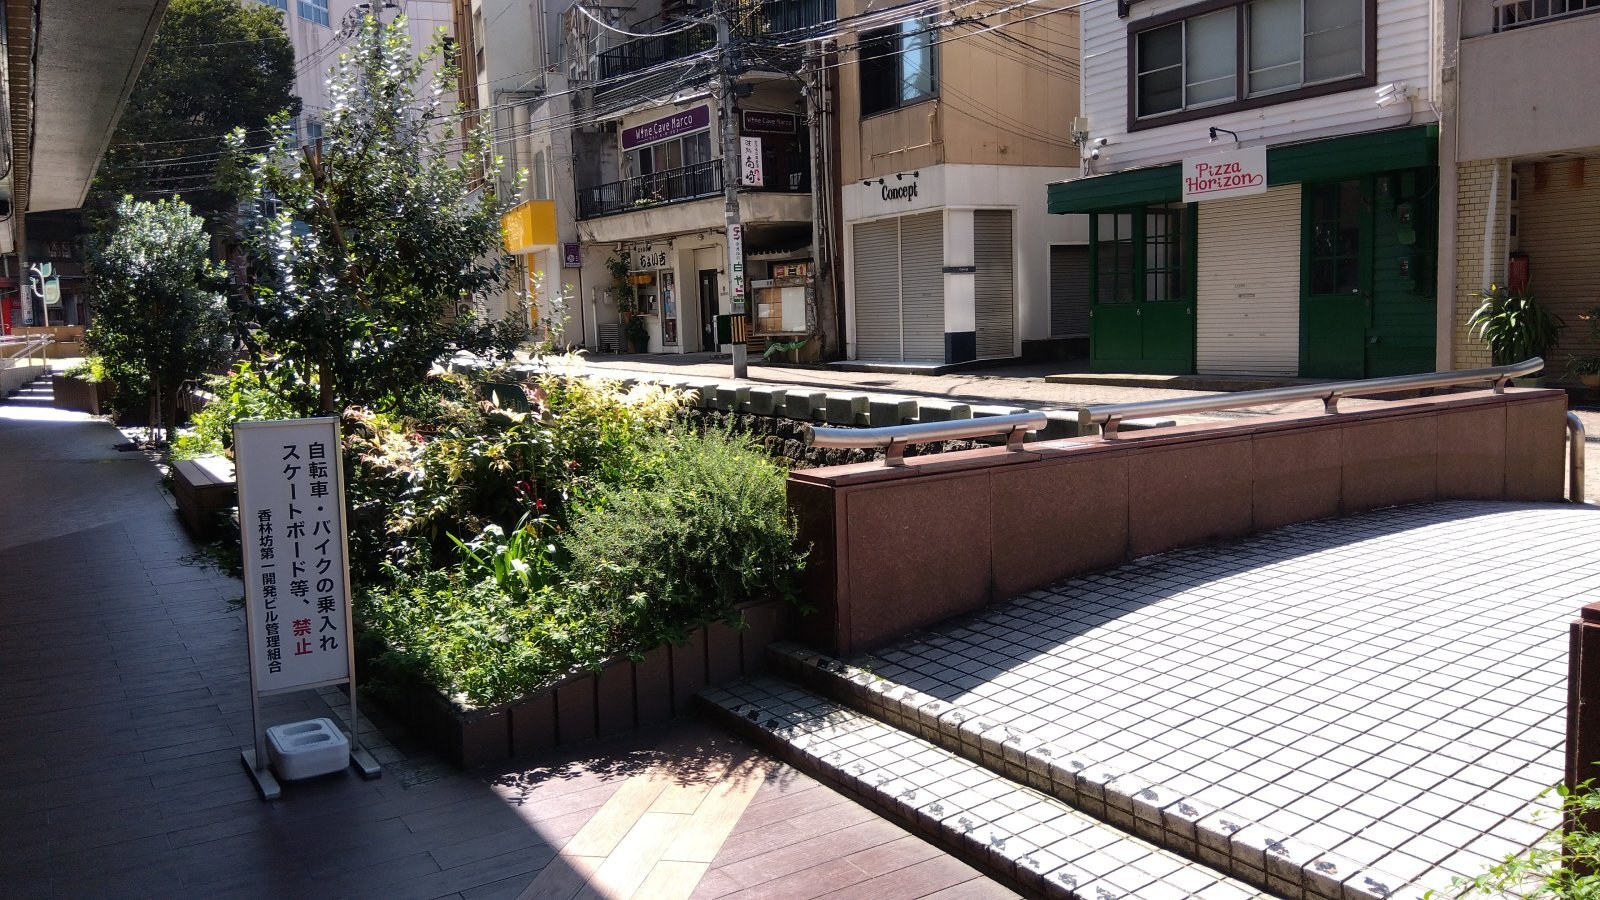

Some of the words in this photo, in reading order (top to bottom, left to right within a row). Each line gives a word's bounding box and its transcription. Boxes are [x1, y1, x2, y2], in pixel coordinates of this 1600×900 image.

[635, 126, 652, 140] Wine
[653, 121, 670, 135] Cave
[671, 114, 693, 129] Marco
[762, 117, 776, 125] Cave
[776, 118, 793, 126] Marco
[1196, 161, 1242, 178] Pizza
[882, 181, 918, 201] Concept
[1186, 173, 1263, 194] Horizon
[282, 444, 313, 656] スケートボード等、禁止
[308, 442, 338, 652] 自転車・バイクの乗入れ
[257, 508, 282, 674] 香林坊第一開発ビル管理組合
